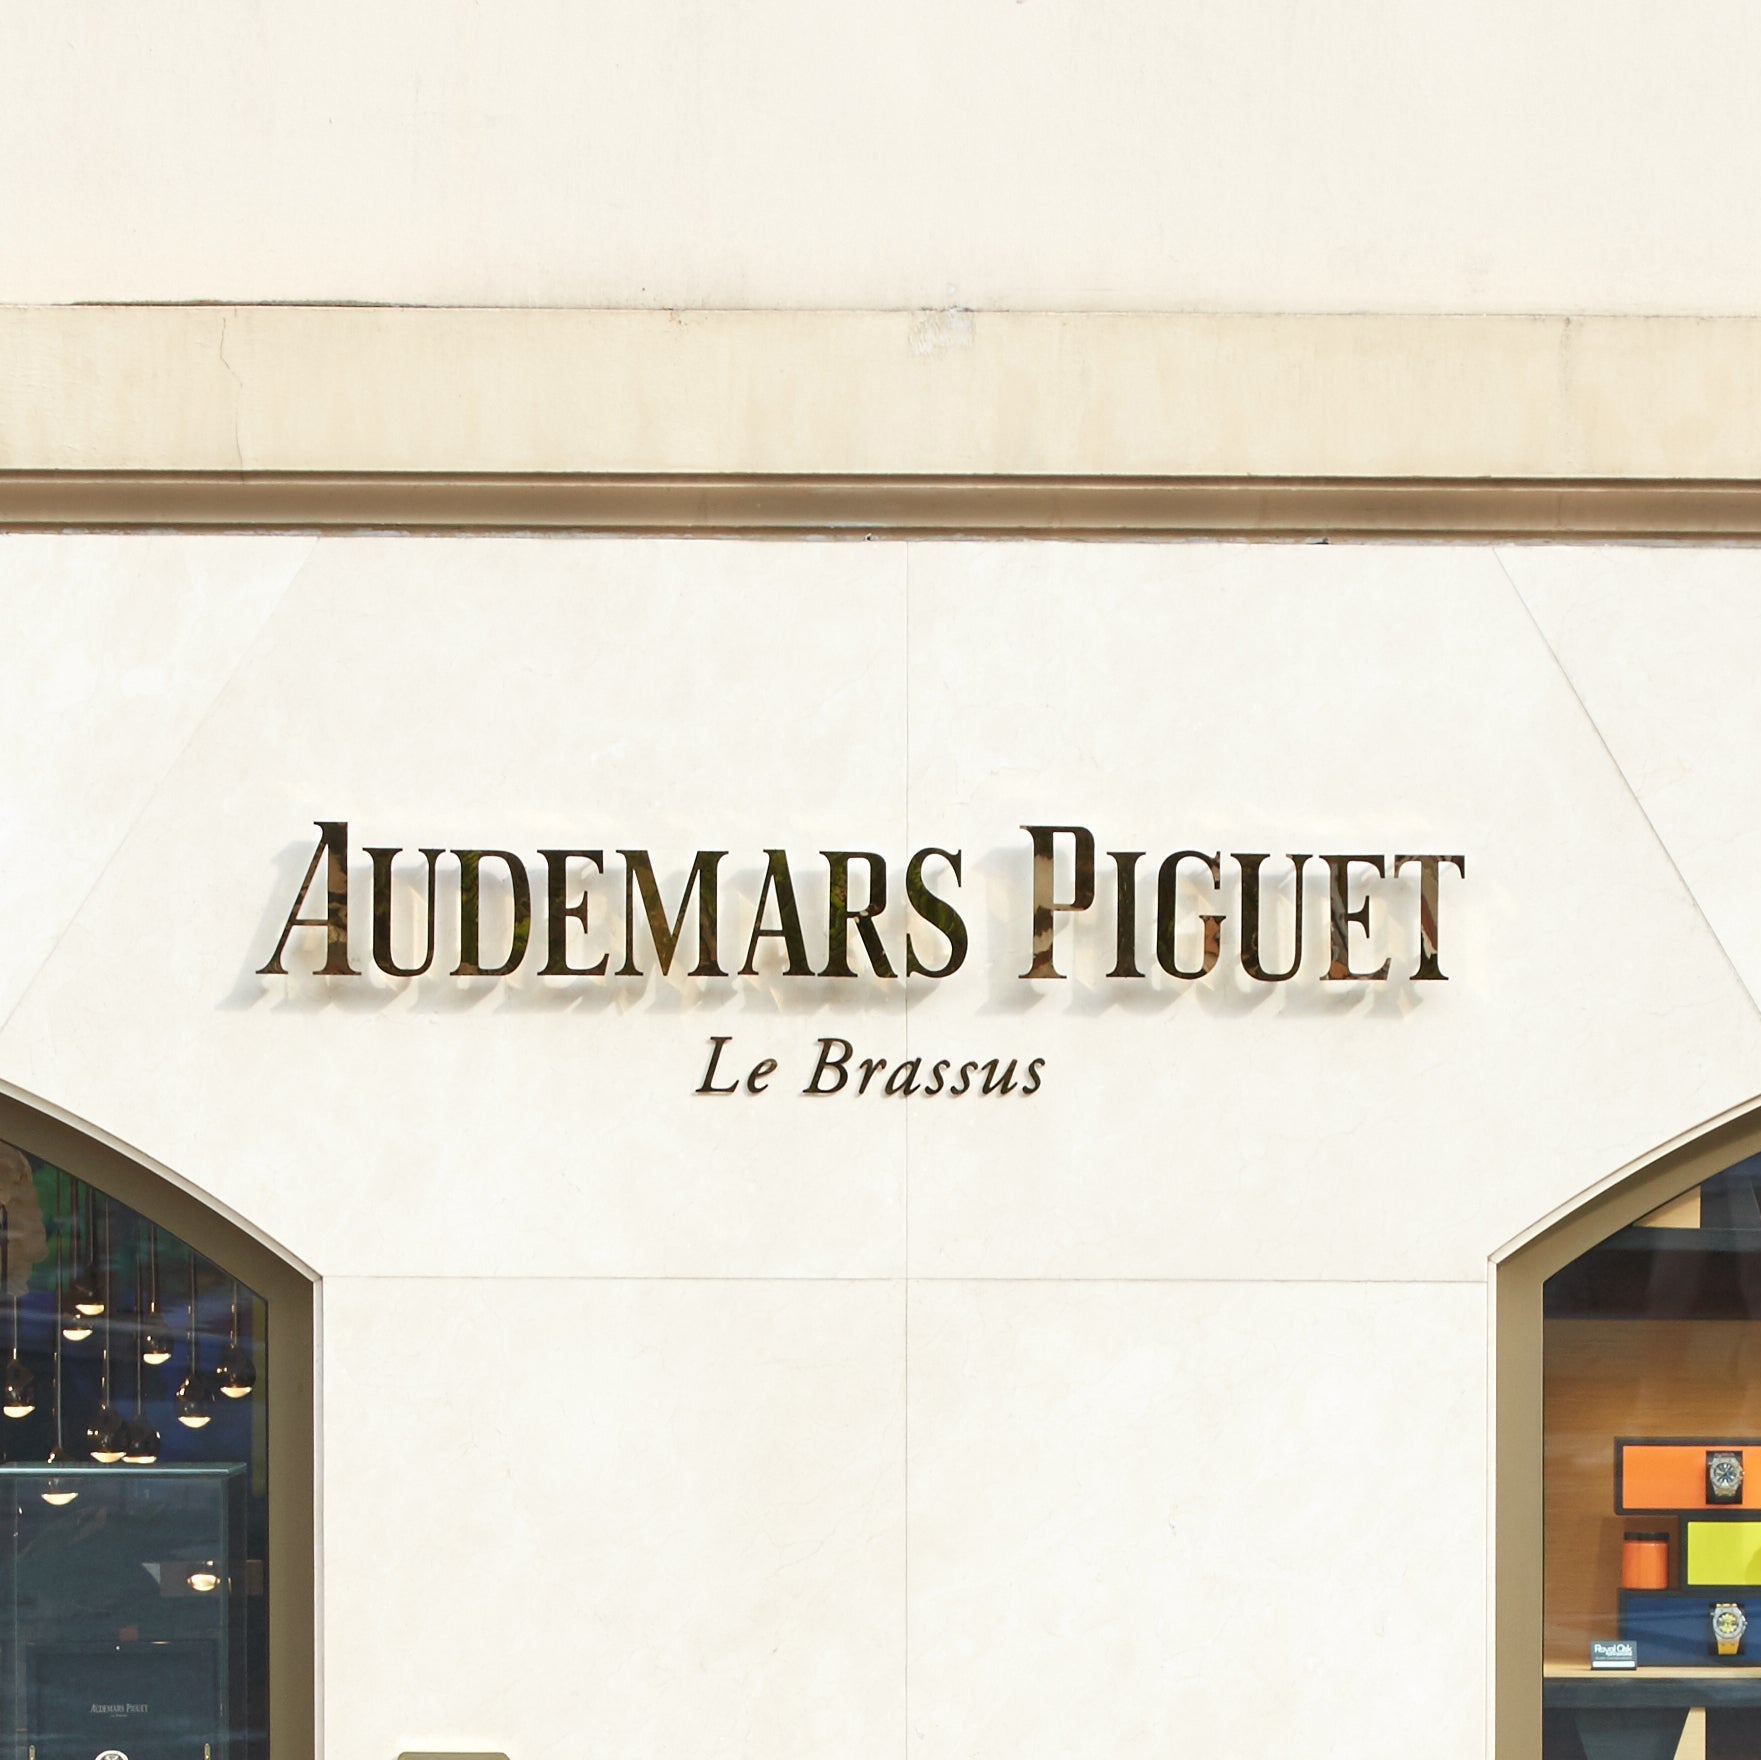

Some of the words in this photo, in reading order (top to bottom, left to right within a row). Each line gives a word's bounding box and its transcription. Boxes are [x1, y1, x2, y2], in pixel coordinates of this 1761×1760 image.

[255, 820, 969, 979] AUDEMARS
[1017, 823, 1467, 982] PIGUET
[695, 1035, 778, 1095] Le
[802, 1037, 1046, 1097] Brassus
